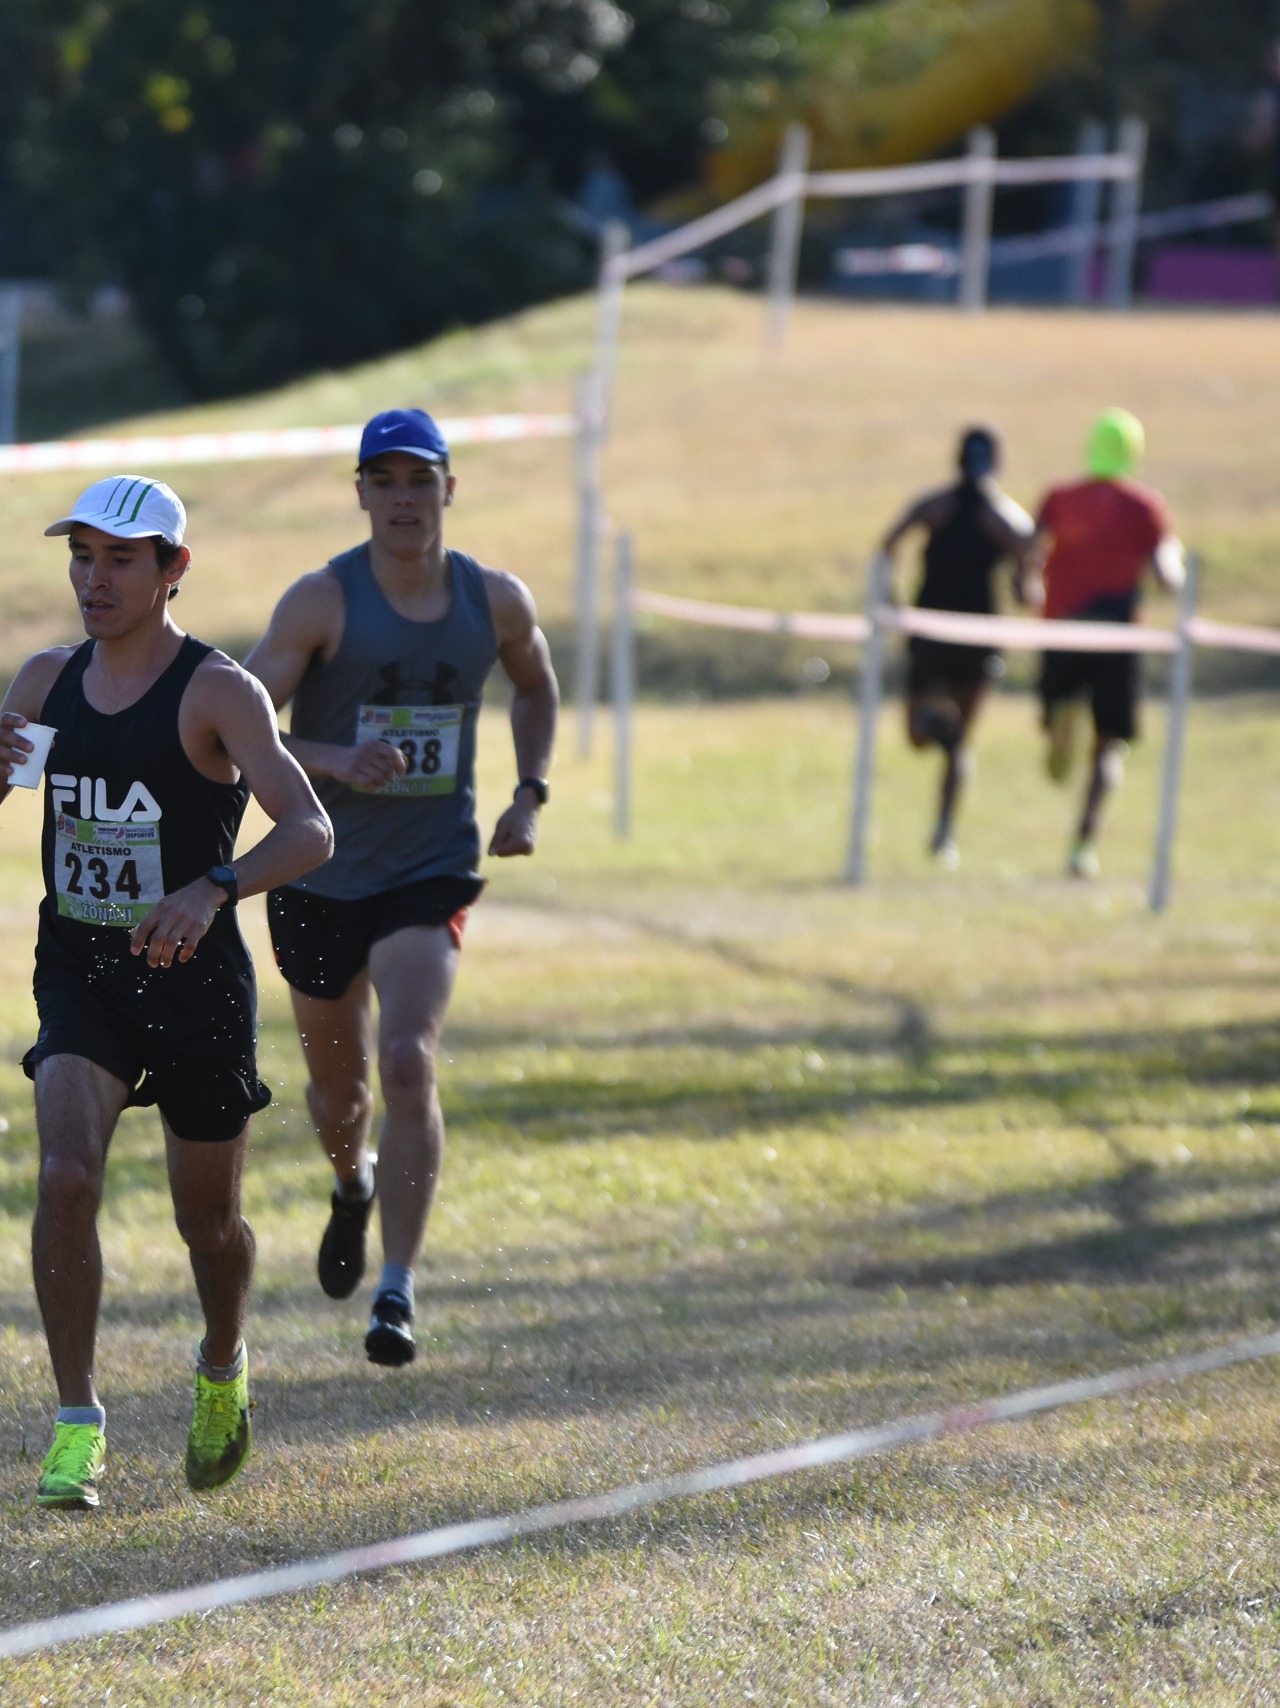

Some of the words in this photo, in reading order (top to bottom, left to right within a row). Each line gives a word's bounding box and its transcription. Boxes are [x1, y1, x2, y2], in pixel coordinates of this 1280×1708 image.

[382, 729, 439, 737] ATLETISMO
[377, 738, 442, 775] 38
[50, 773, 163, 822] FILA
[71, 842, 132, 856] ATLETISMO
[65, 852, 141, 900] 234
[82, 903, 118, 921] ZONA
[121, 908, 133, 922] II
